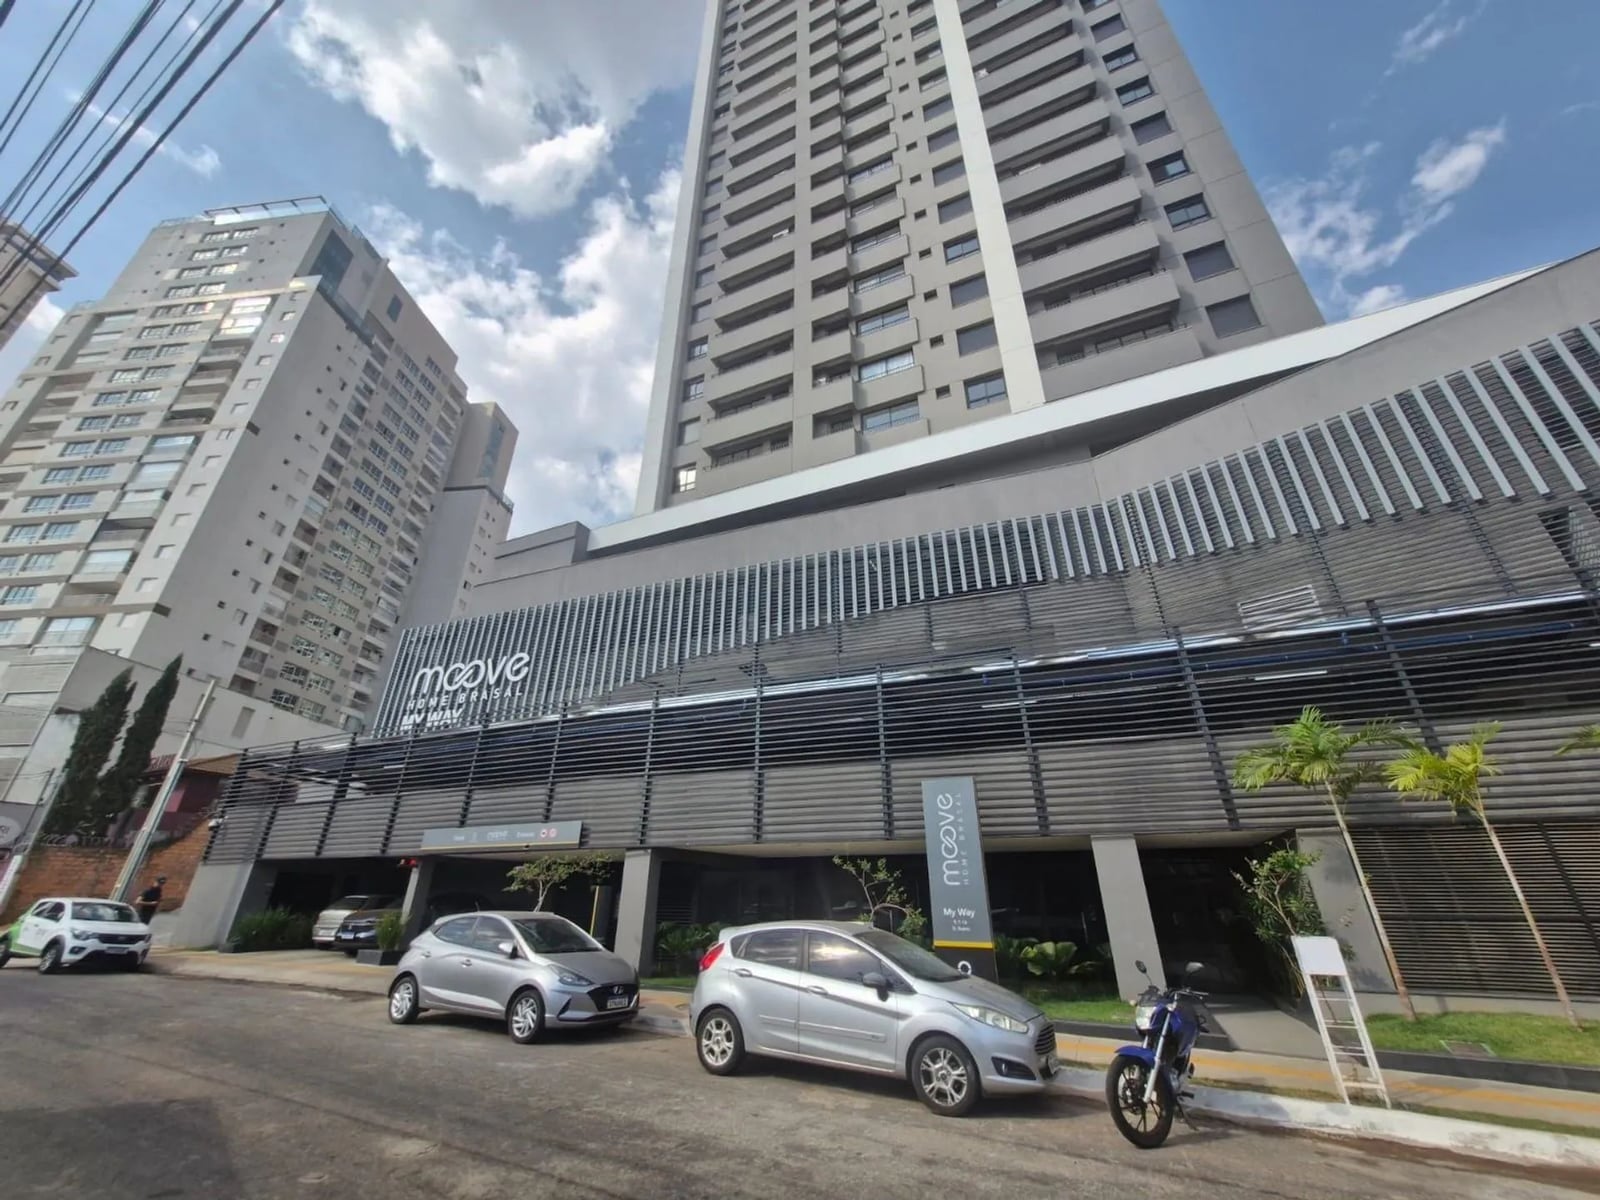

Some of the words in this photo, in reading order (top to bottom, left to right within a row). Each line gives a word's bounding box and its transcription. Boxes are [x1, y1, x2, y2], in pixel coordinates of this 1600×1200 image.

[411, 652, 530, 695] moove
[407, 695, 449, 710] HOME
[459, 684, 523, 703] BRASAL
[937, 793, 960, 886] moove
[943, 907, 956, 918] My
[957, 907, 976, 919] Way
